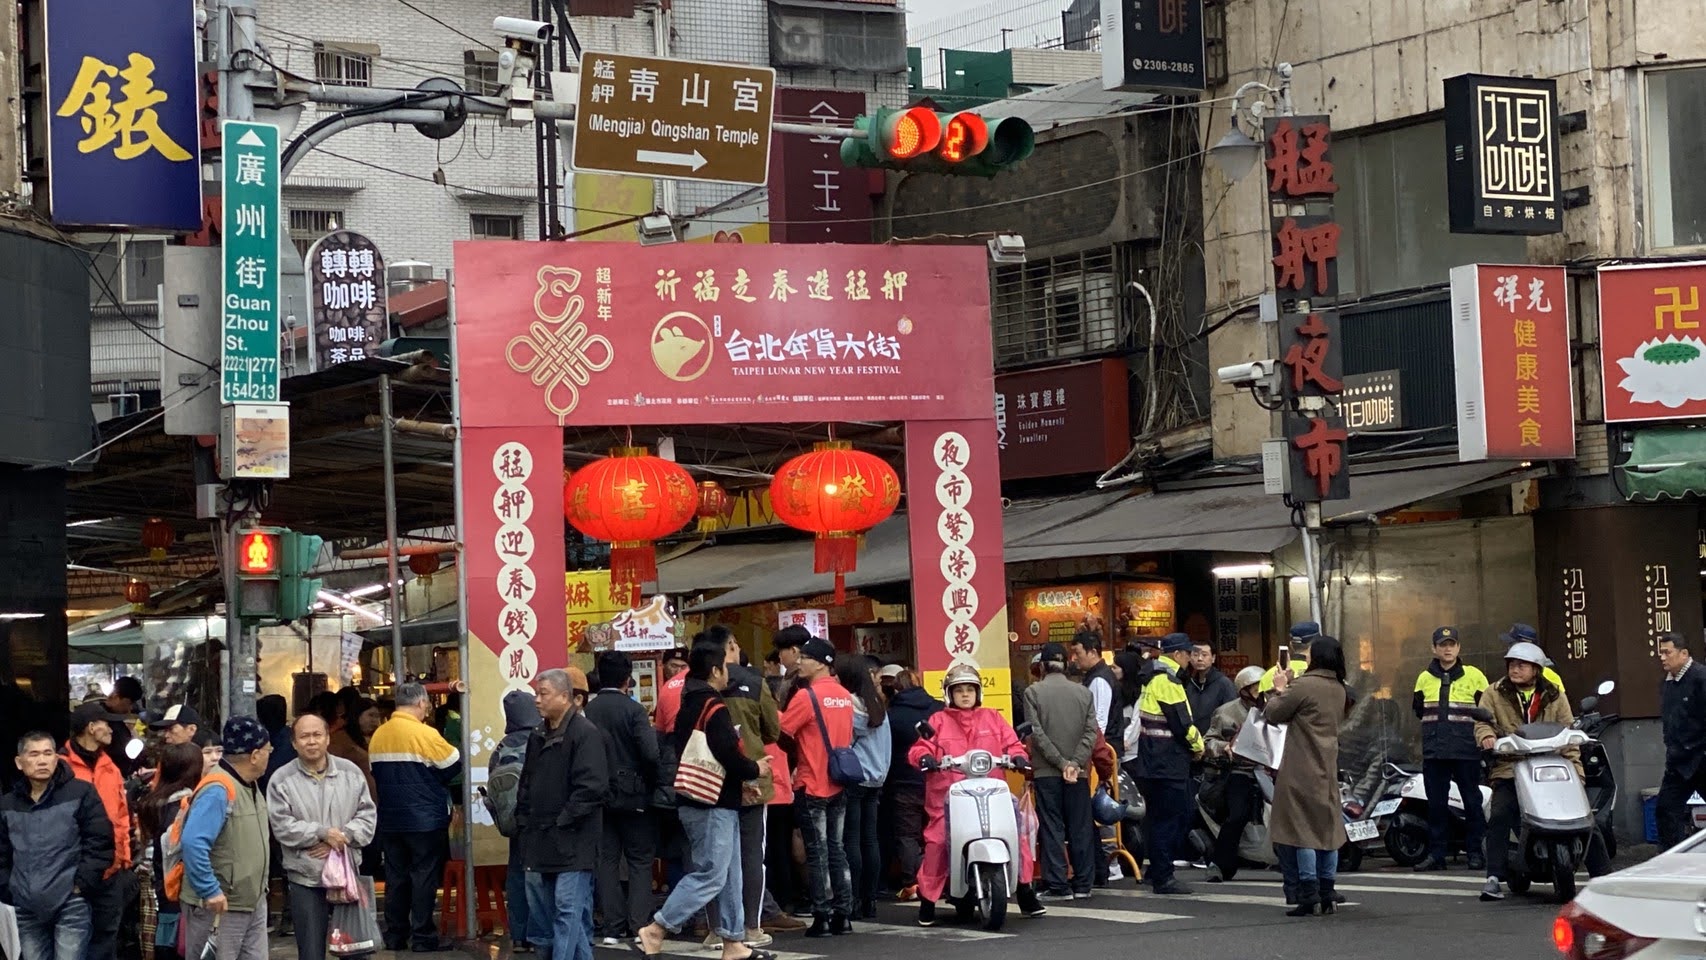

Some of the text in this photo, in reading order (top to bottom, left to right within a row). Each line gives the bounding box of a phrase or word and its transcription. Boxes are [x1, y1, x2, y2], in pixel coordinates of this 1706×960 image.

[1143, 59, 1195, 73] 2306-2885
[628, 67, 763, 113] 青山宮
[56, 52, 194, 162] 錶
[588, 113, 759, 148] (Mengjia) Qingshan Temple
[235, 152, 267, 289] 廣州街
[321, 248, 375, 278] 轉轉
[226, 294, 271, 311] Guan
[323, 280, 376, 309] 咖啡
[1264, 118, 1349, 498] 艋舺夜市
[1493, 274, 1552, 314] 祥光
[226, 314, 269, 332] Zhou
[226, 335, 248, 351] St.
[724, 328, 901, 361] 台北年貨大街
[252, 357, 276, 373] 277
[732, 365, 901, 376] TAIPEI LUNAR NEW YEAR FESTIVAL
[225, 382, 276, 400] 154 213
[1513, 318, 1542, 448] 健康美食
[1017, 388, 1066, 409] 珠寶銀樓
[1653, 564, 1672, 657] 九日咖
[823, 696, 852, 707] Origin
